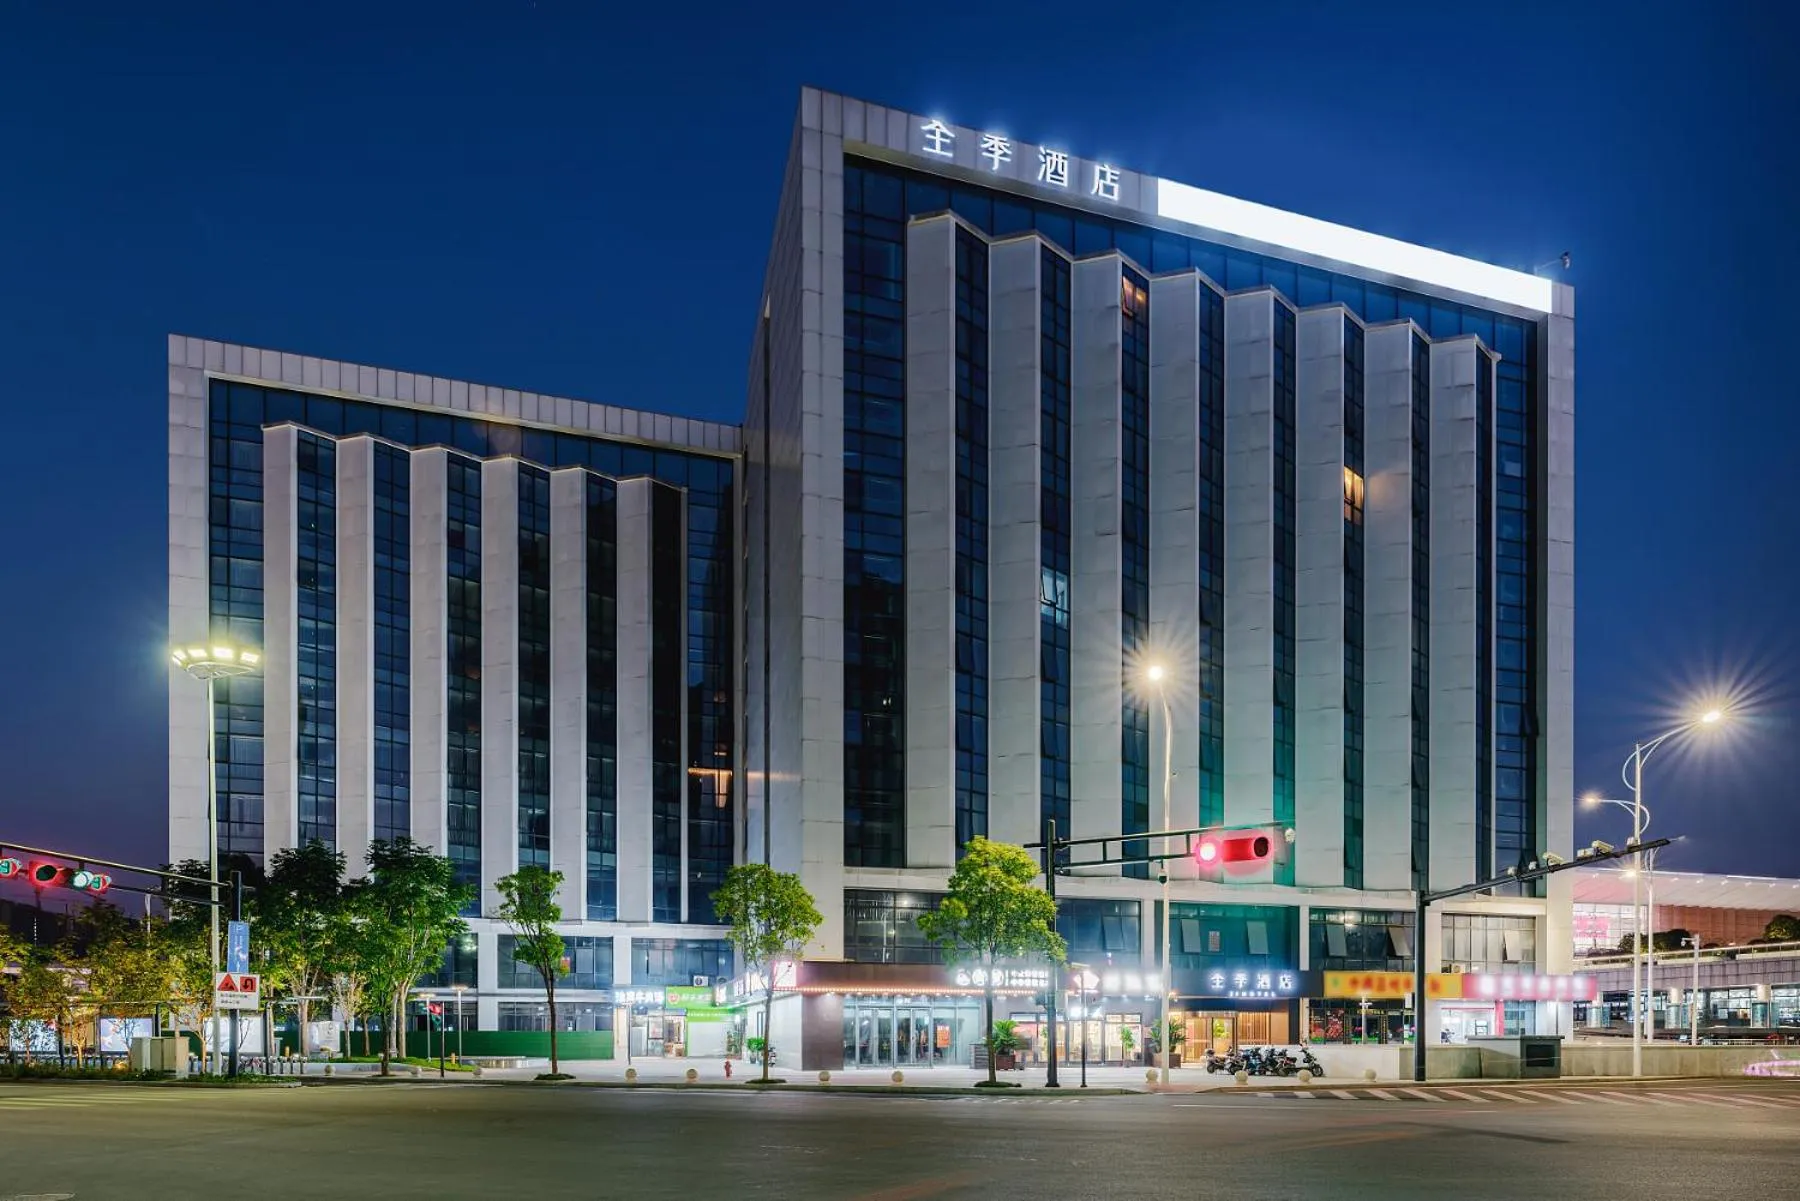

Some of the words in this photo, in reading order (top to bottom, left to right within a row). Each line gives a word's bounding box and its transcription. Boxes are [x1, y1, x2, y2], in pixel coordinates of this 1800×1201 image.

[921, 119, 1121, 201] 全季酒店
[1210, 972, 1293, 990] 全季酒店
